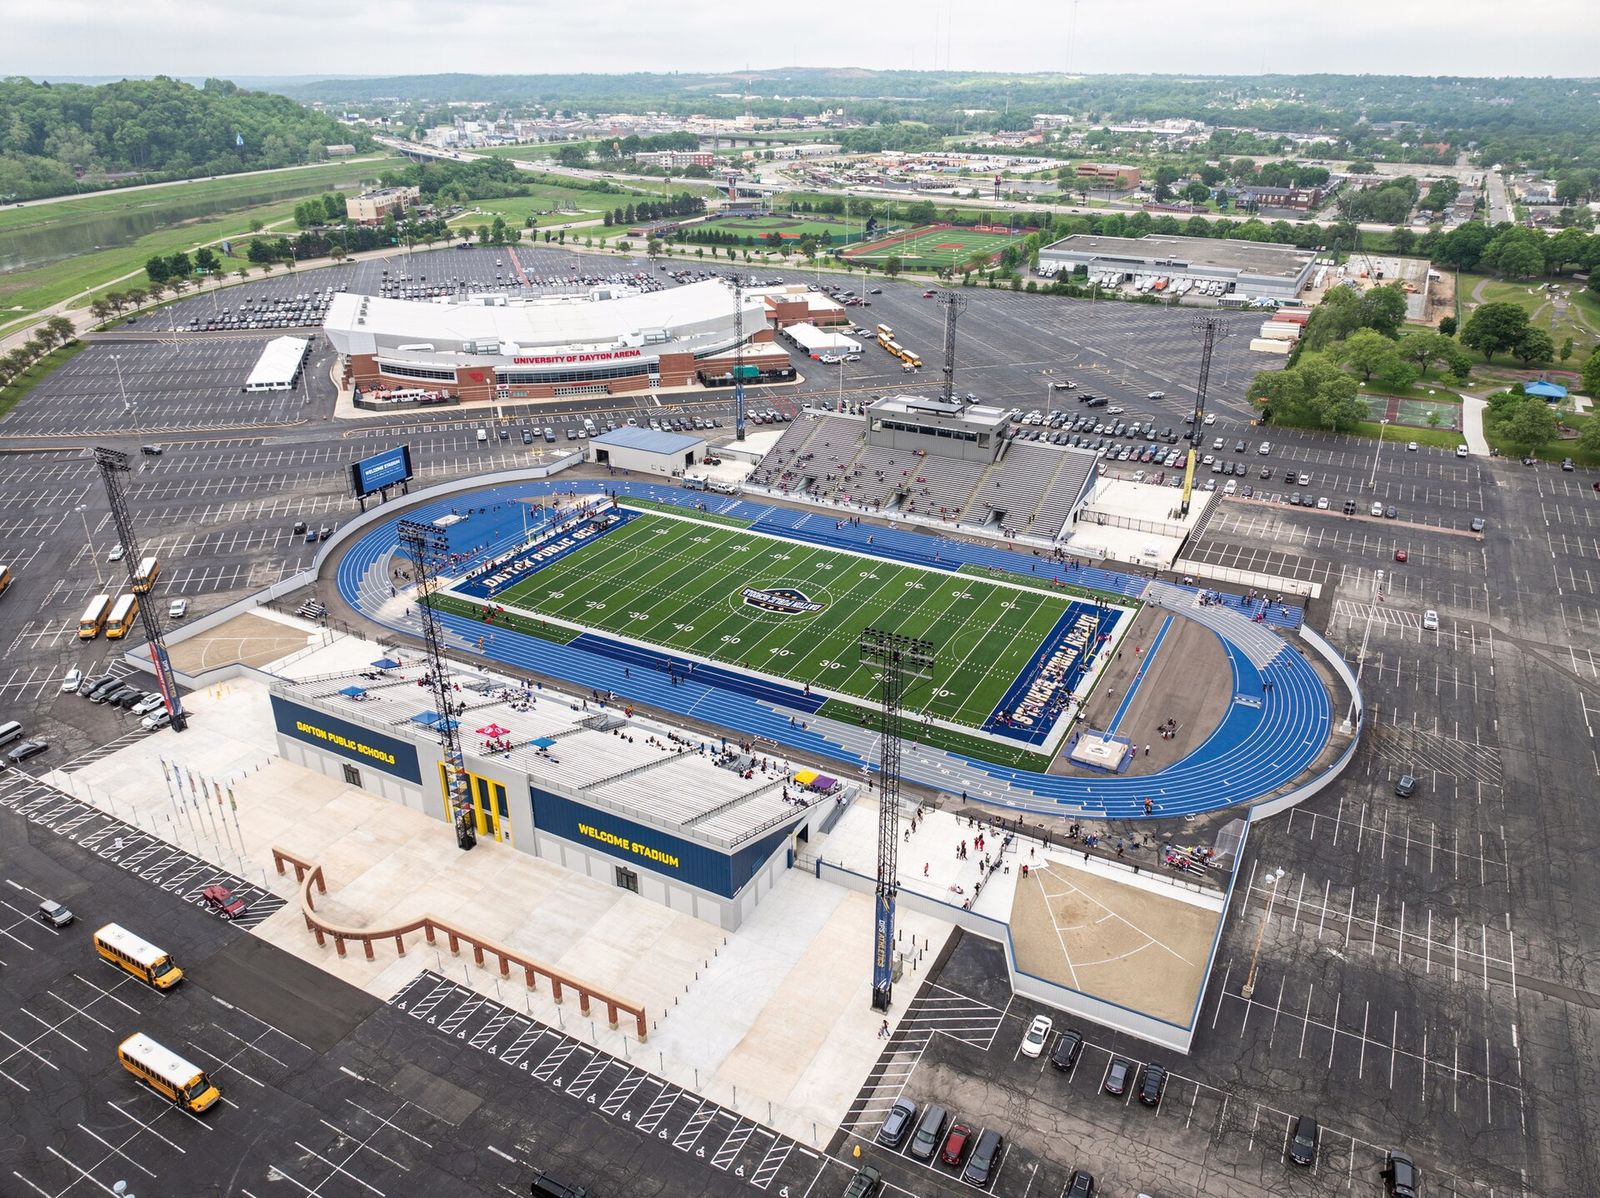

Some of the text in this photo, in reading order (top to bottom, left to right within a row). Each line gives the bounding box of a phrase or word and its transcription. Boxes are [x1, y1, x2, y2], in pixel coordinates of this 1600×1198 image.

[513, 356, 565, 364] UNIVERSITY
[579, 352, 612, 362] DAYTON
[614, 349, 641, 358] ARENA
[483, 556, 536, 588] DAYTON
[531, 537, 576, 561] PUBLIC
[586, 601, 606, 609] 20
[629, 611, 649, 620] 30
[674, 623, 694, 632] 40
[721, 635, 741, 644] 50
[769, 647, 790, 656] 40
[819, 659, 841, 669] 30
[931, 687, 950, 697] 10
[296, 721, 396, 765] DAYTON PUBLIC SCHOOLS
[578, 823, 679, 867] WELCOME STADIUM
